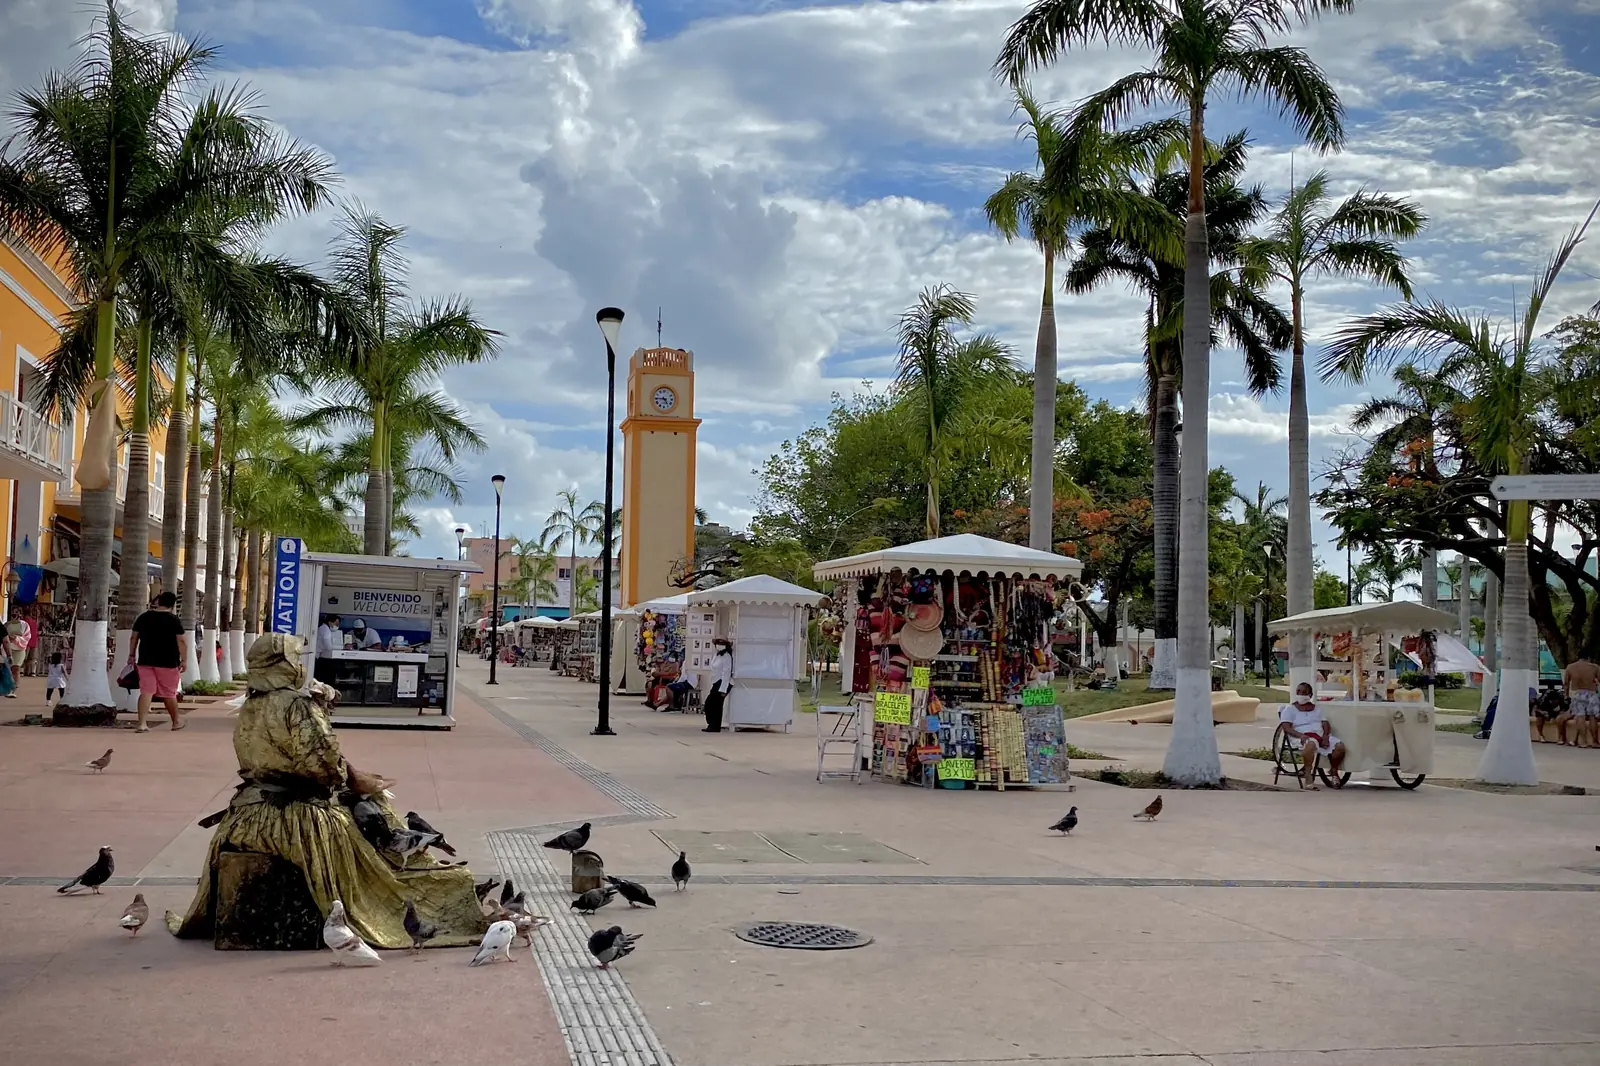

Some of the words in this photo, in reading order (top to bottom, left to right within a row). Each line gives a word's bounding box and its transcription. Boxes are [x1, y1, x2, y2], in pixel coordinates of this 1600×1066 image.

[353, 591, 422, 603] BIENVENIDO
[353, 601, 421, 615] WELCOME
[880, 693, 886, 701] I
[889, 694, 907, 702] MAKE
[875, 700, 908, 710] BRACELETS
